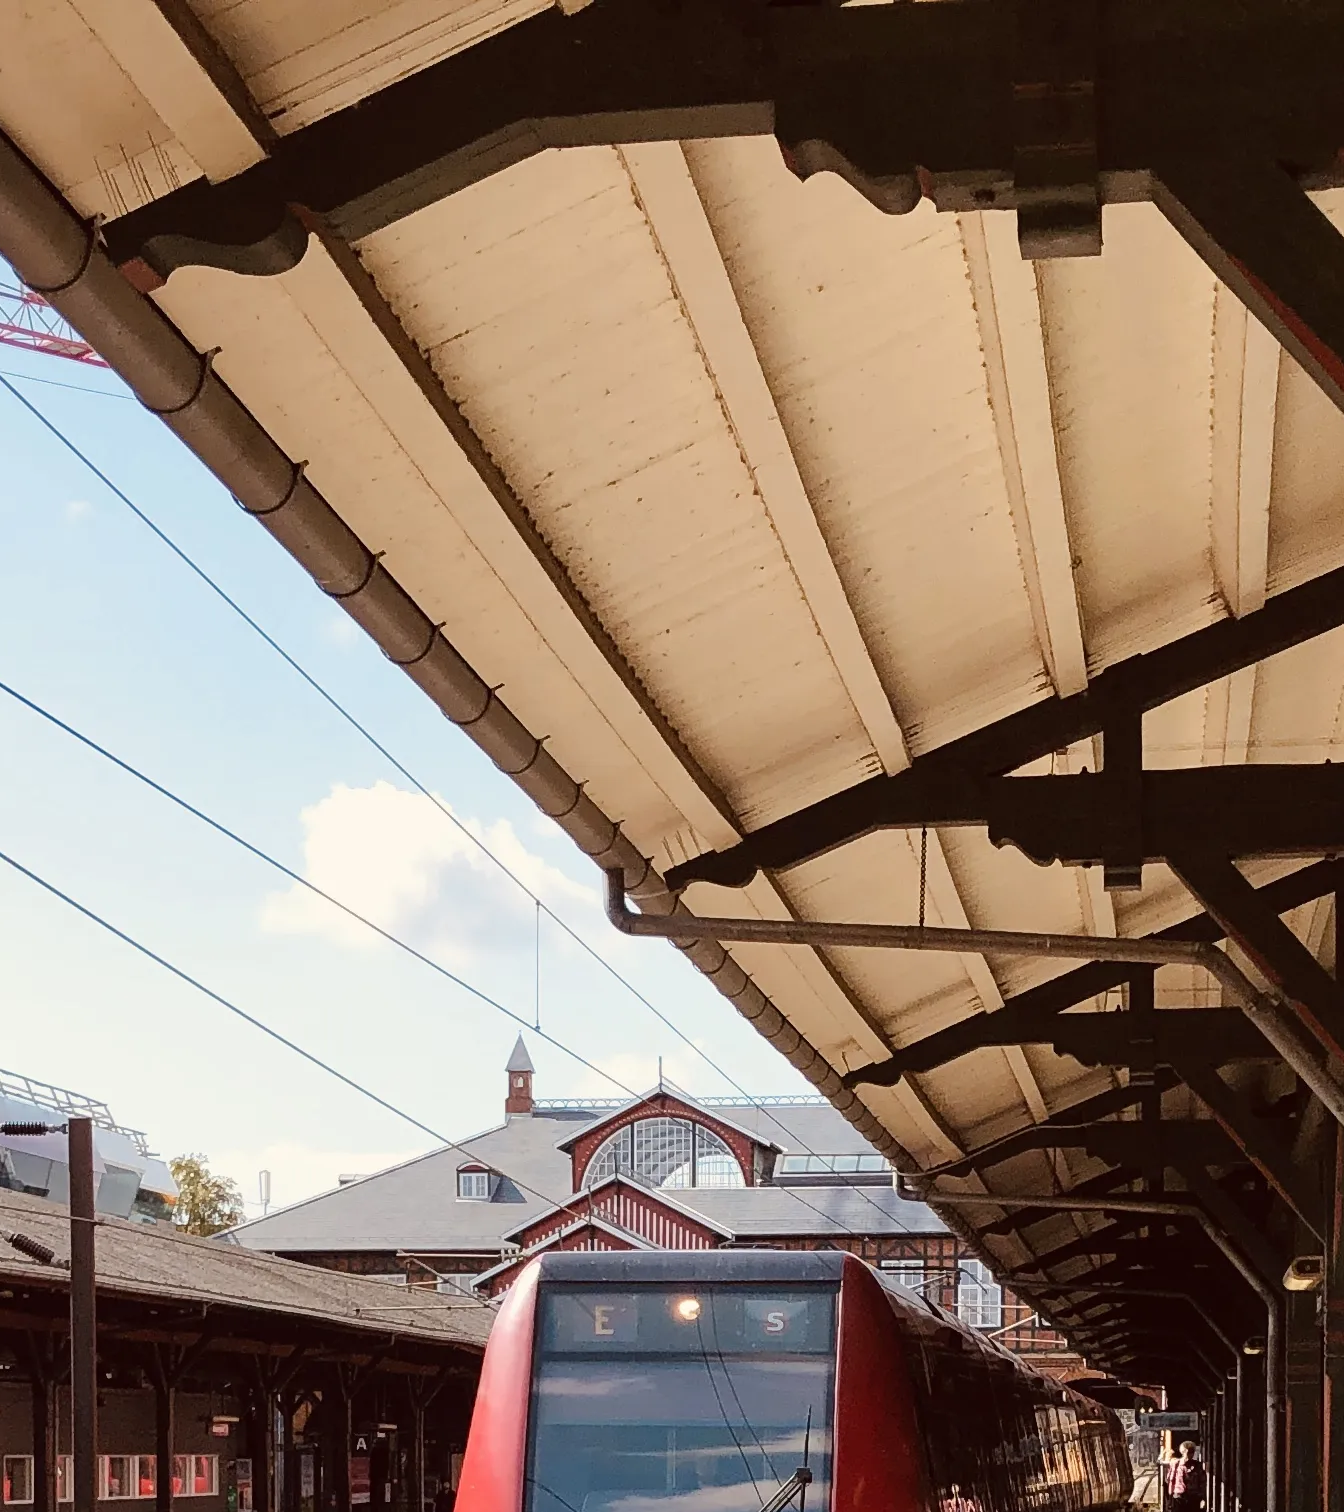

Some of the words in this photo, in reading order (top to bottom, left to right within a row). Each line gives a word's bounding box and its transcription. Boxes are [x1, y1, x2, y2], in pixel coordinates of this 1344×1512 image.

[595, 1305, 615, 1335] E
[767, 1312, 785, 1332] S
[356, 1437, 367, 1451] A
